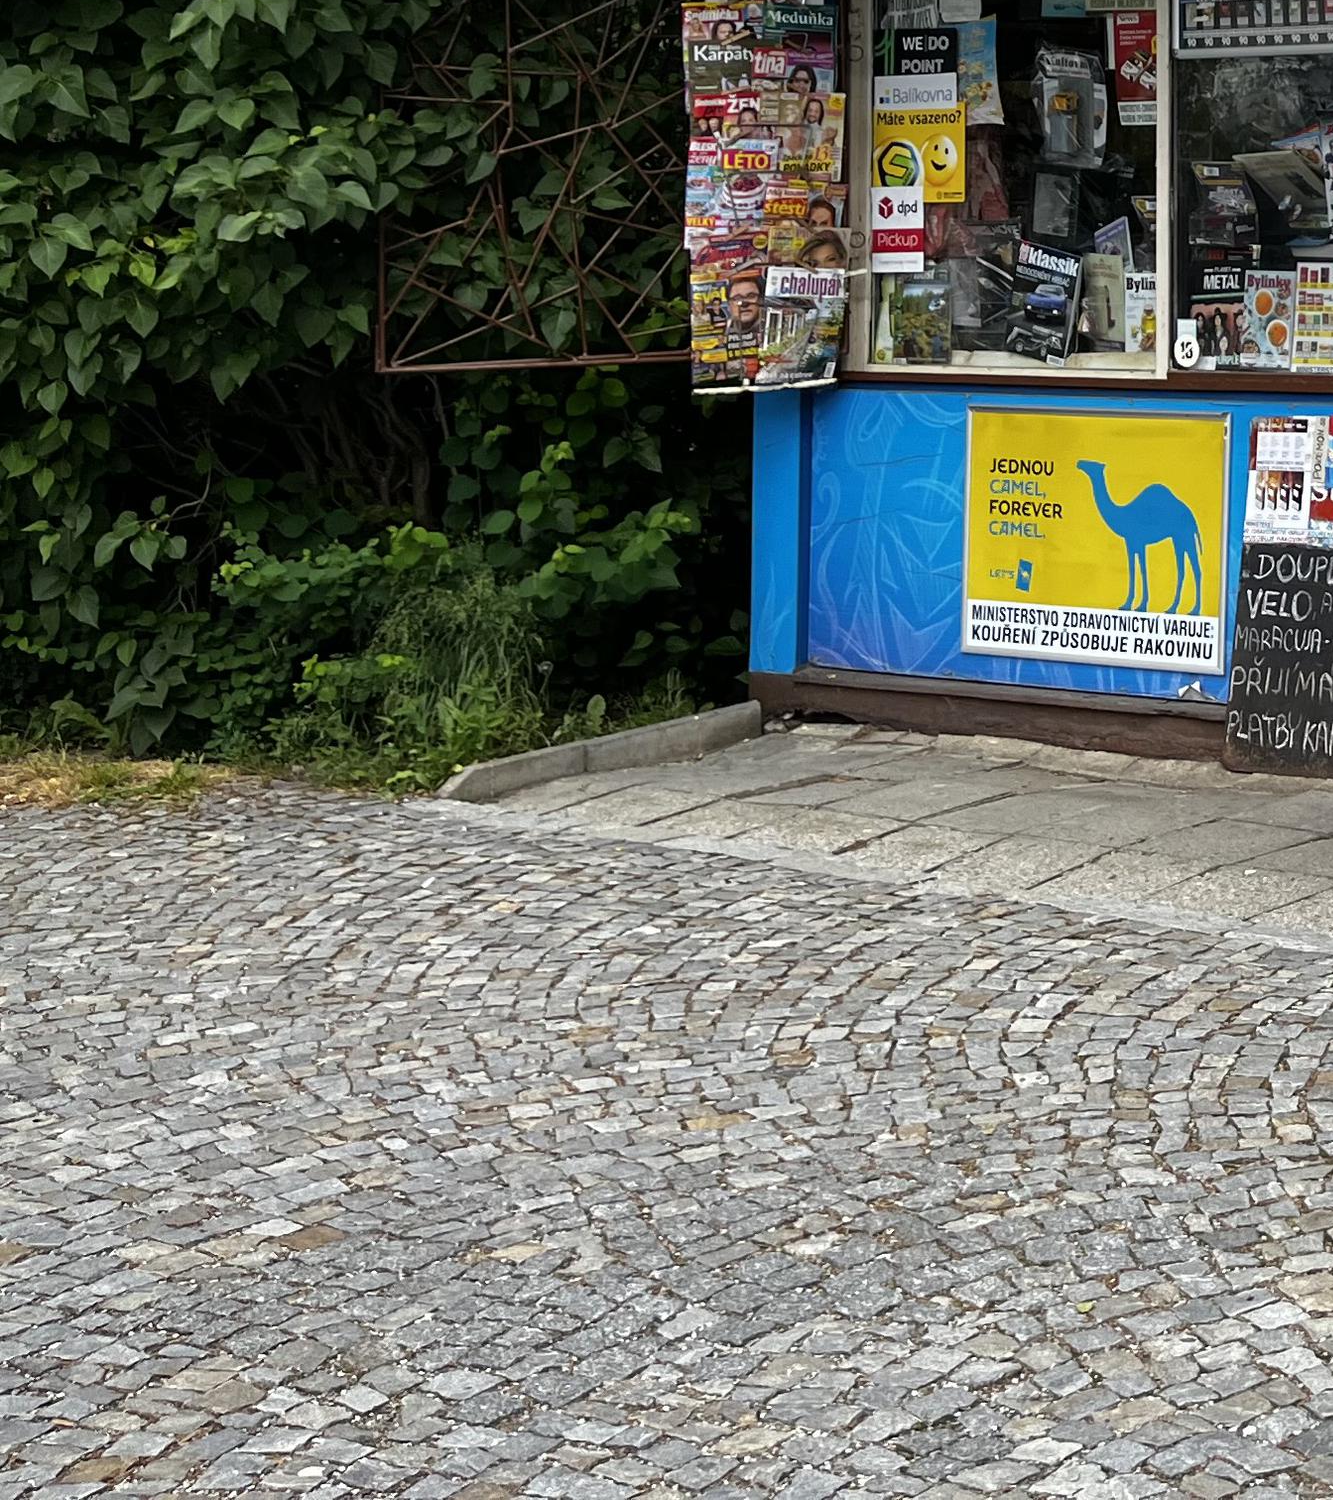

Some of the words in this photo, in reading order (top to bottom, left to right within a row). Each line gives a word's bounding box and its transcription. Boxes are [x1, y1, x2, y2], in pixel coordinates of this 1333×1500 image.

[768, 10, 834, 27] Meduňka
[902, 35, 924, 51] WE
[928, 35, 950, 51] DO
[754, 51, 785, 76] tina
[901, 59, 943, 74] POINT
[893, 87, 953, 105] Balíkovna
[876, 109, 906, 127] Máte
[909, 109, 962, 126] vsazeno?
[724, 150, 769, 170] LÉTO
[897, 199, 918, 216] dpd
[877, 231, 919, 250] Pickup
[1027, 246, 1080, 277] klassik
[1203, 274, 1241, 291] METAL
[1247, 274, 1292, 294] Bylinky
[990, 458, 1054, 476] JEDNOU
[990, 479, 1046, 498] CAMEL,
[989, 500, 1063, 519] FOREVER
[989, 521, 1046, 538] CAMEL.
[972, 605, 1058, 627] MINISTERSTVO
[1063, 609, 1160, 635] ZDRAVOTNICTVÍ
[1163, 617, 1214, 639] VARUJE:
[972, 624, 1036, 645] KOUŘENÍ
[1041, 629, 1128, 653] ZPŮSOBUJE
[1134, 637, 1213, 660] RAKOVINU
[1226, 708, 1296, 750] PLATBY
